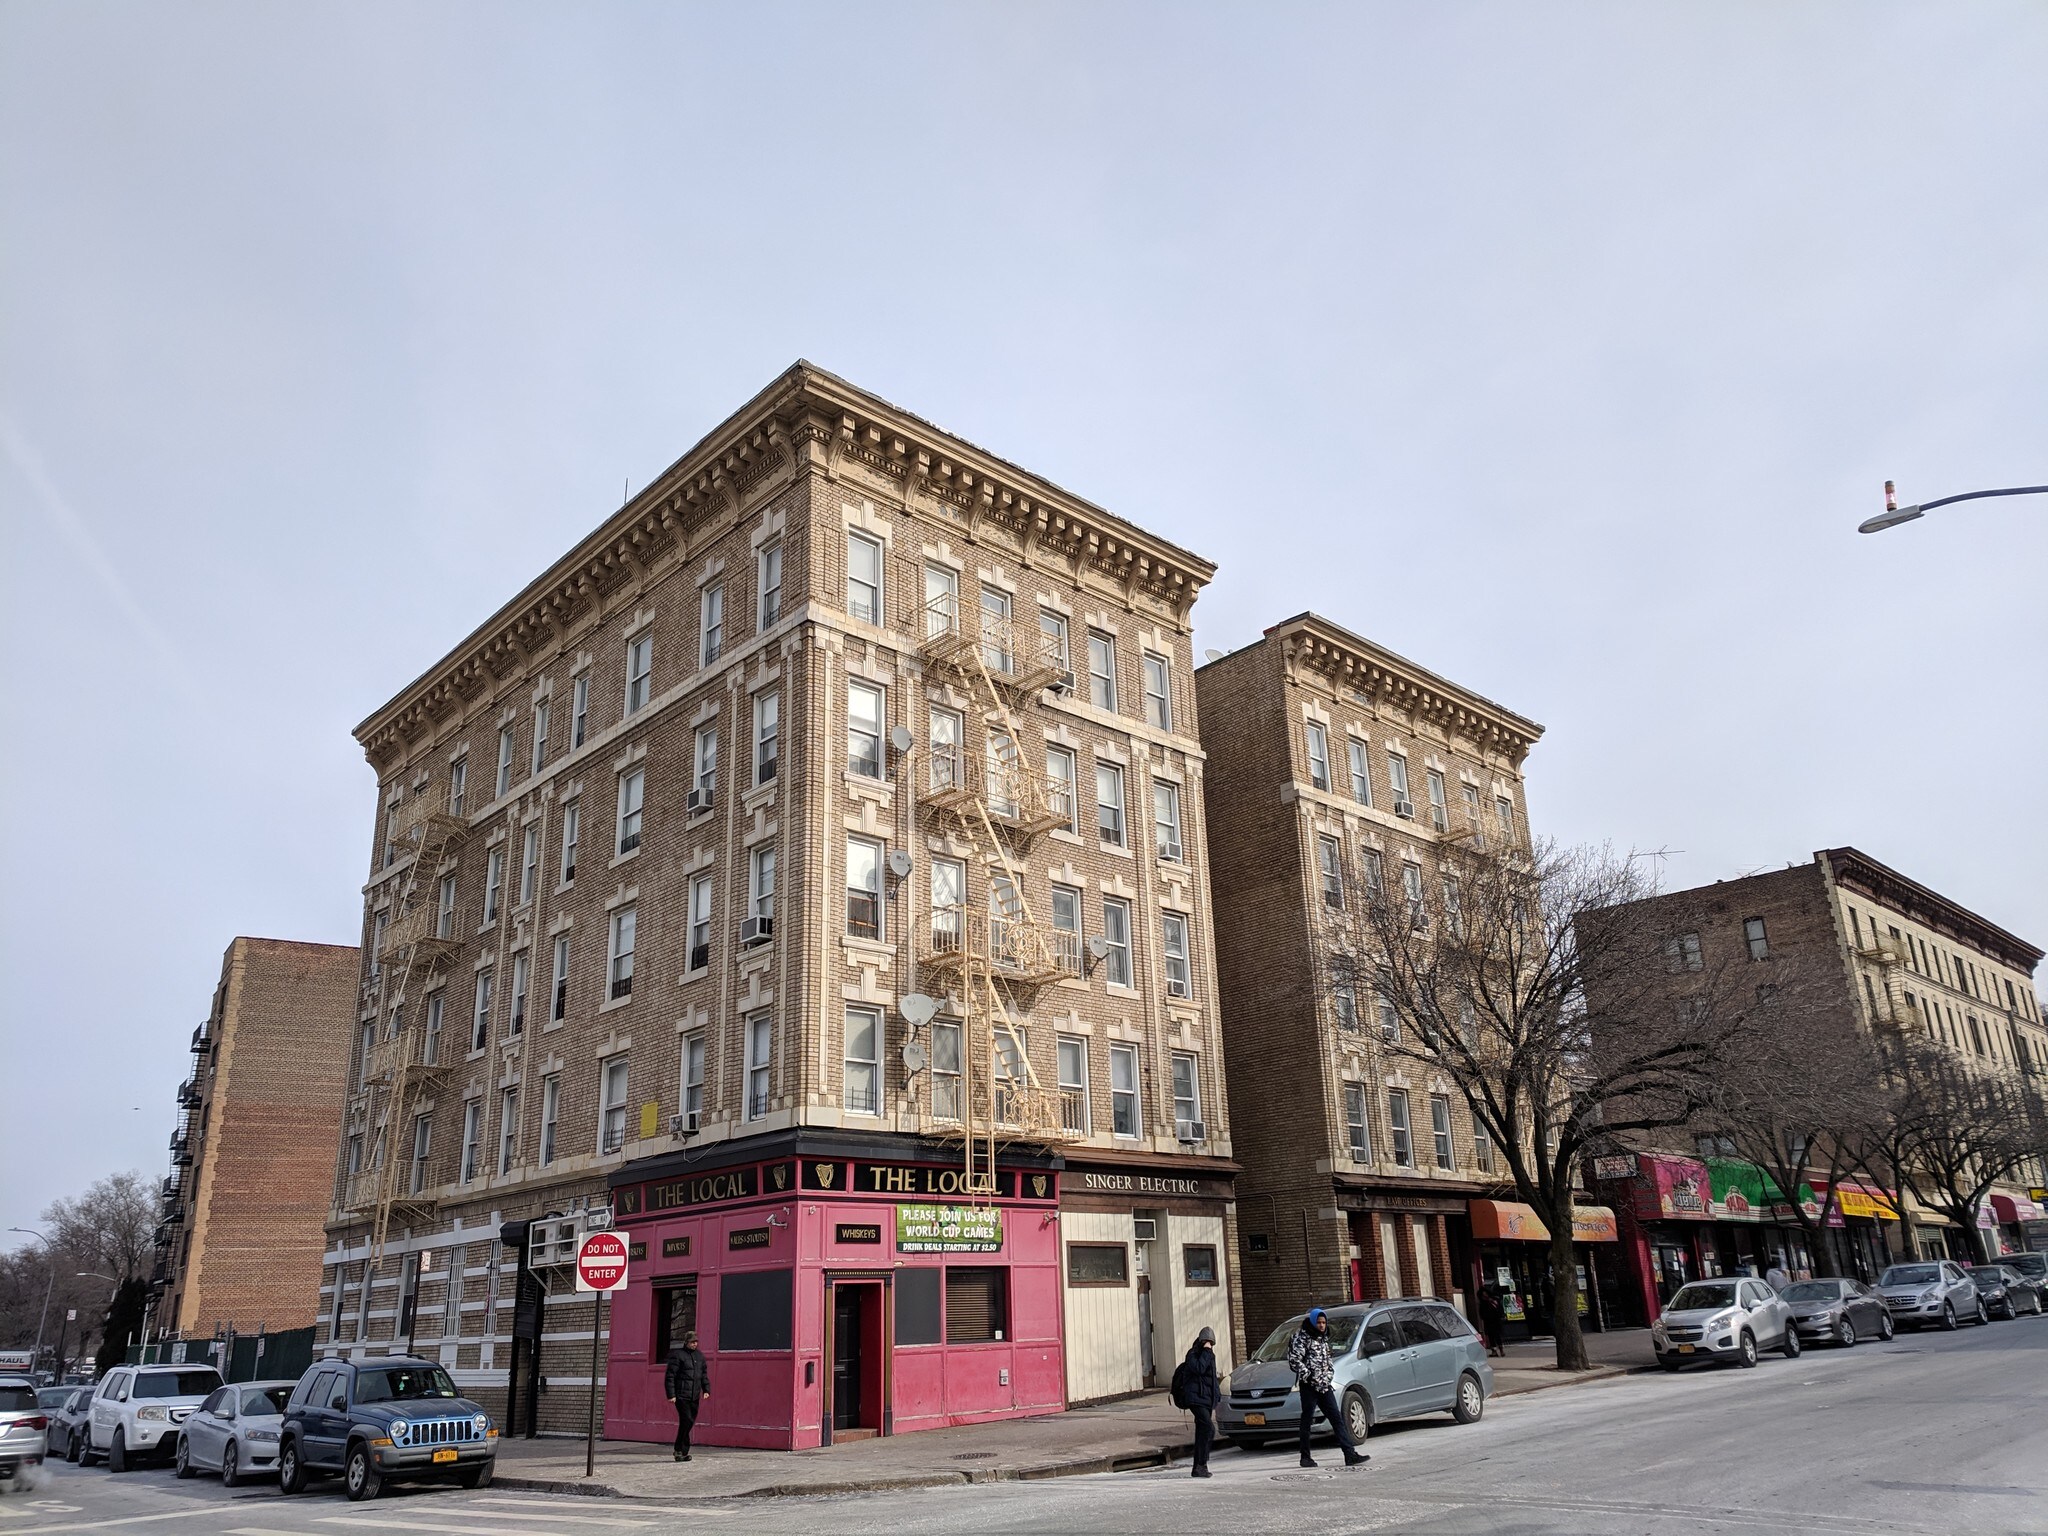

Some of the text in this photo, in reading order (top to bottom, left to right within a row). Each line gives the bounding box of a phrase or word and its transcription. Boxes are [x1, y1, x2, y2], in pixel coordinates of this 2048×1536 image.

[869, 1166, 1003, 1196] THE LOCAL
[1085, 1173, 1199, 1194] SINGER ELECTRIC
[655, 1172, 747, 1208] THE LOCAL
[902, 1209, 996, 1223] PLEASE JOIN US FOR
[841, 1228, 876, 1239] WHISKEYS
[905, 1225, 995, 1239] WORLD CUP GAMES
[587, 1244, 620, 1254] DO NOT
[902, 1242, 997, 1252] DRINK DEALS STARTING AT $2.50
[588, 1269, 617, 1279] ENTER
